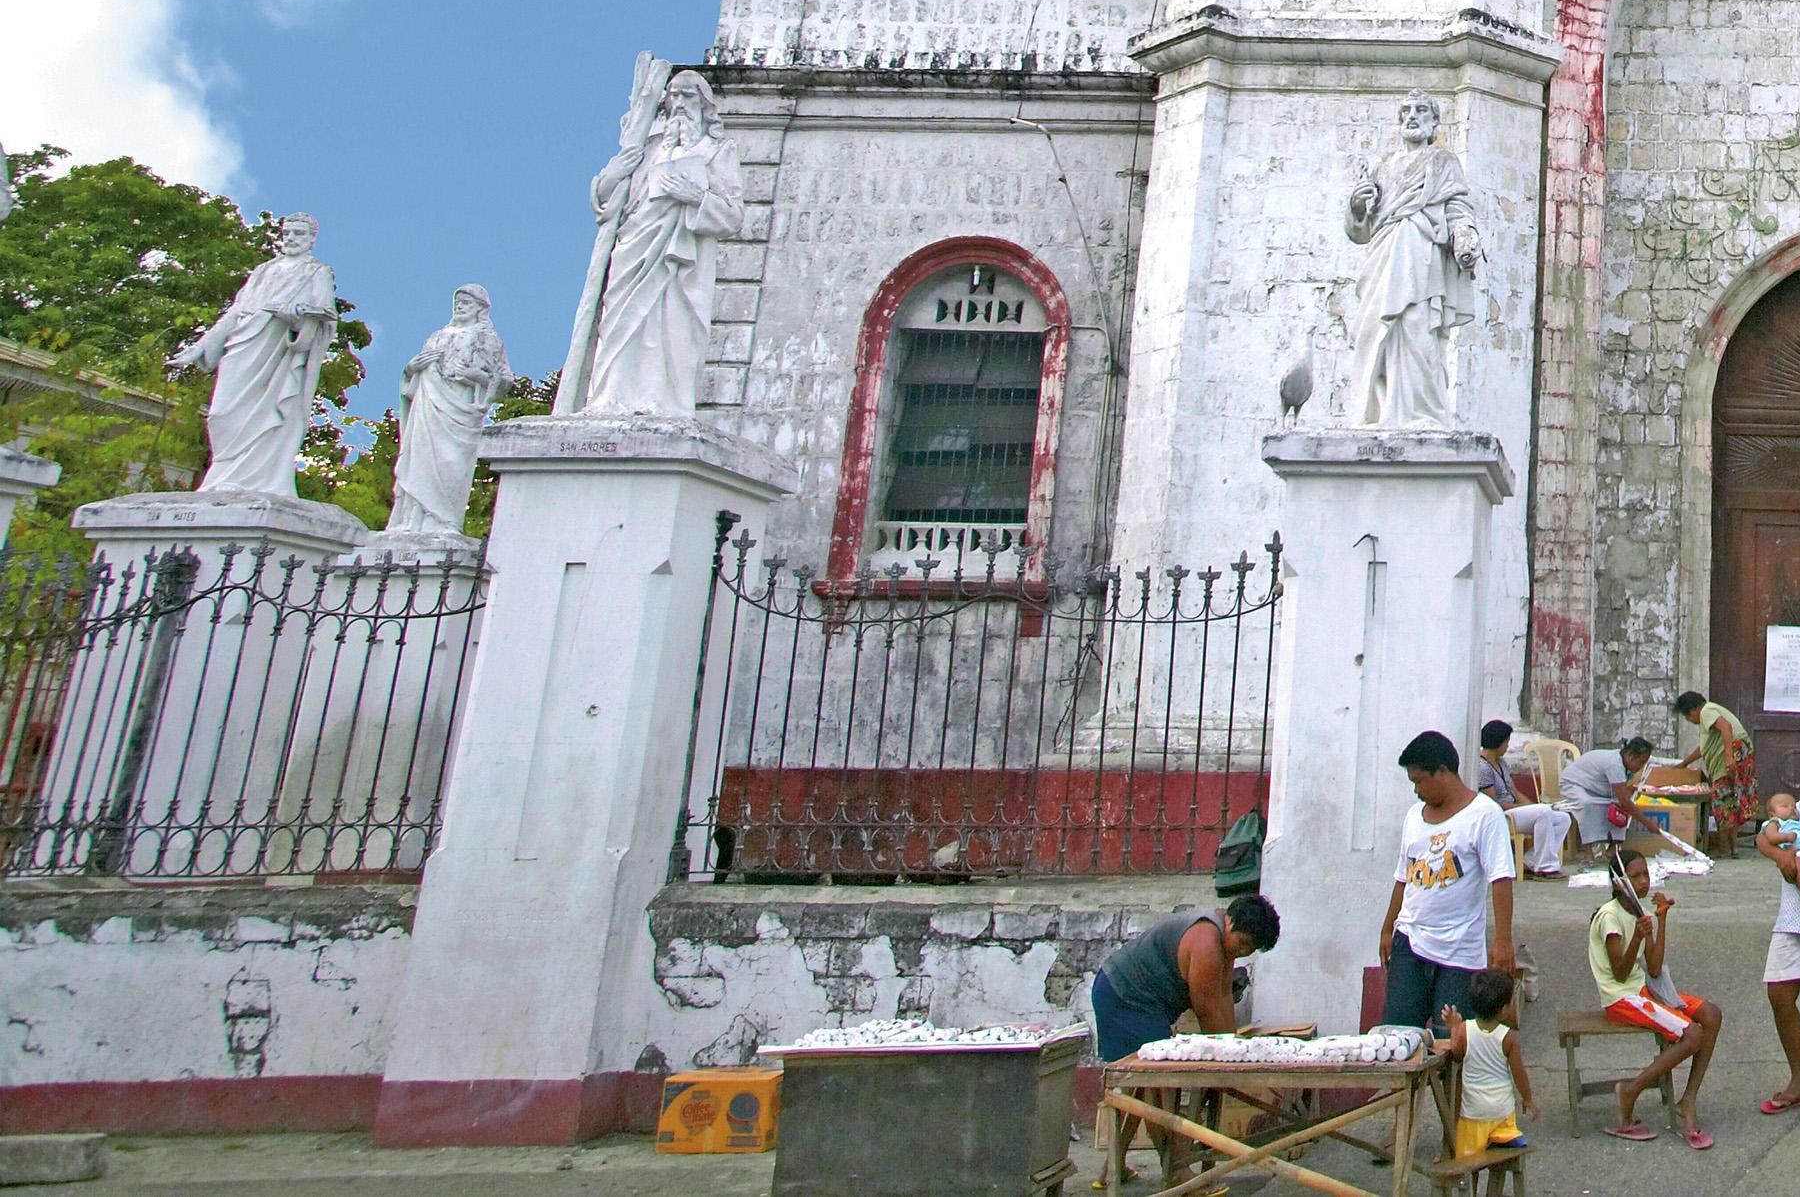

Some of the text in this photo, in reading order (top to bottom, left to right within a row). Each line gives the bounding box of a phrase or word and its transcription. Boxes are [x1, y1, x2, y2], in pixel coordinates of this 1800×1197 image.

[560, 442, 618, 452] SAN ANDRES
[173, 511, 197, 522] MATEO
